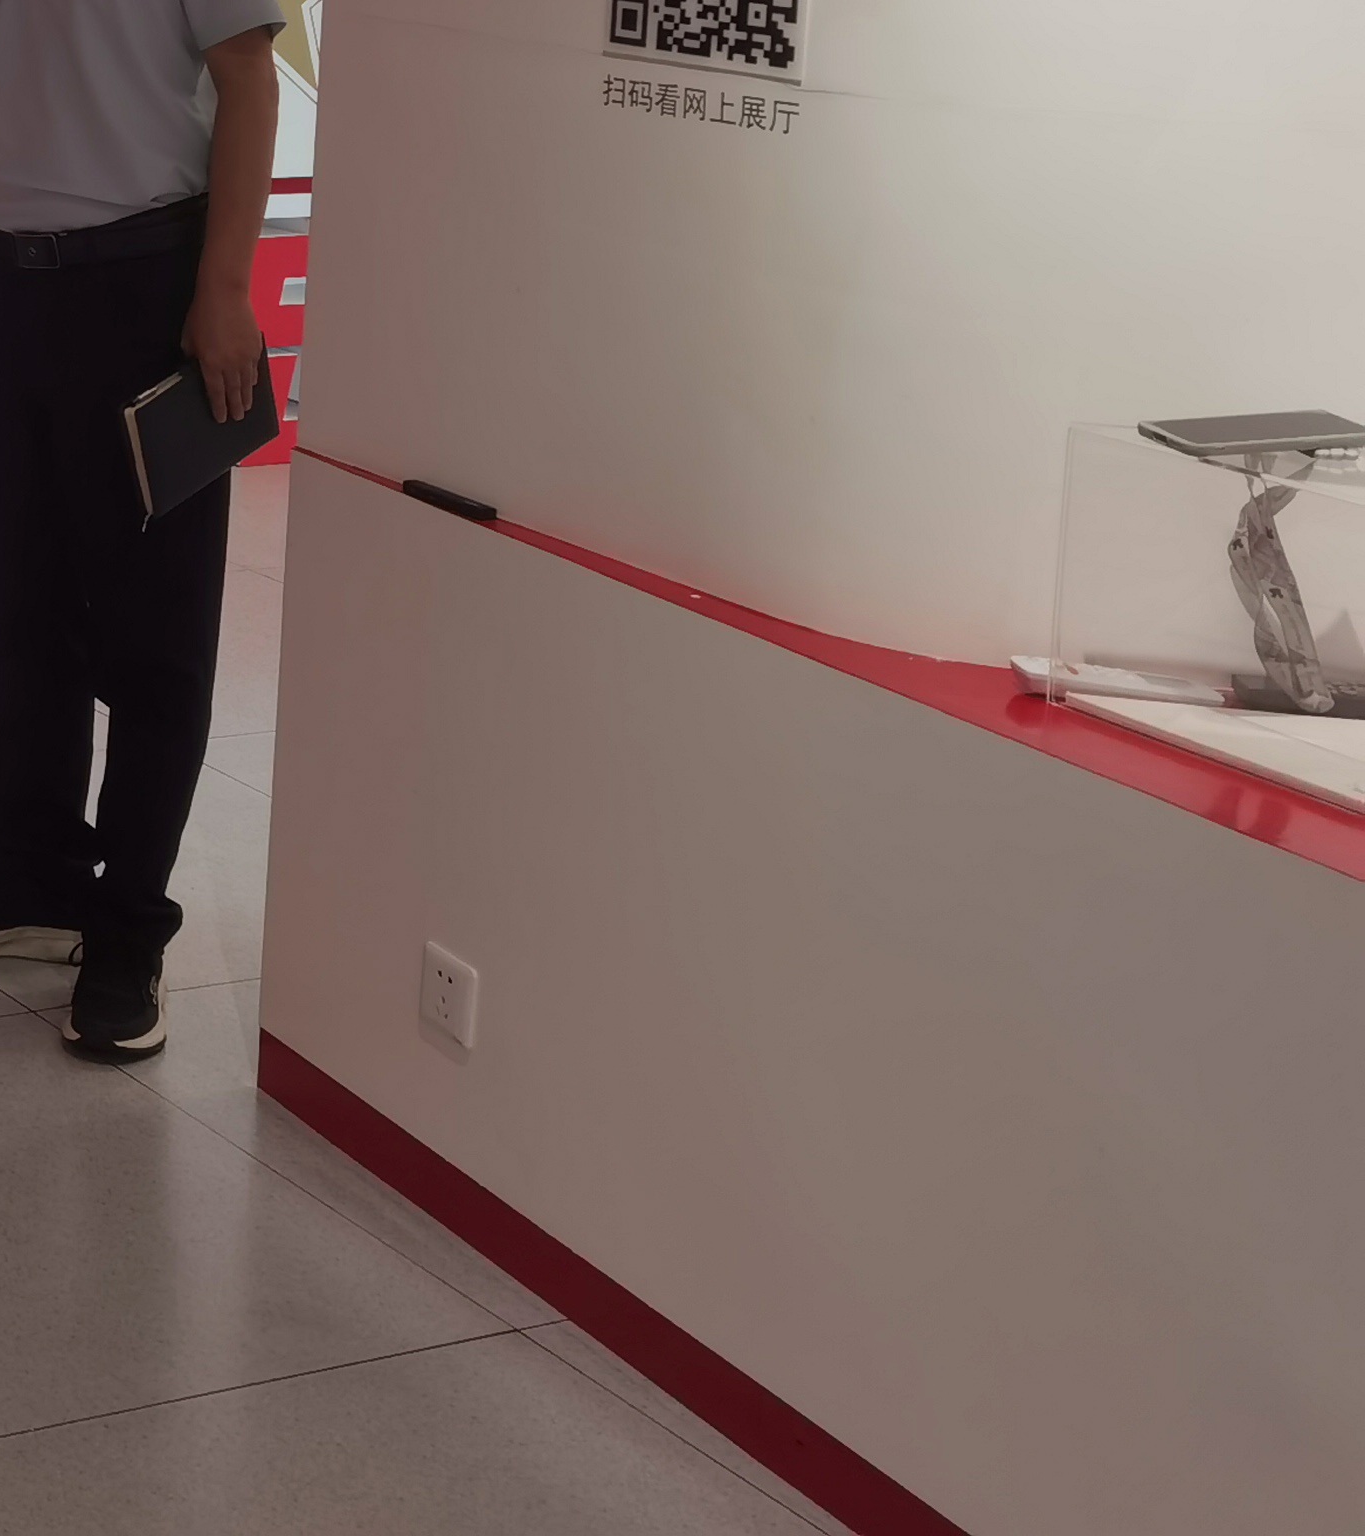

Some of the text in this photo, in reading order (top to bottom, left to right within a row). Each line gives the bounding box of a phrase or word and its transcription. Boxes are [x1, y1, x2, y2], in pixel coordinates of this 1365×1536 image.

[602, 73, 801, 135] 扫码看网上展厅
